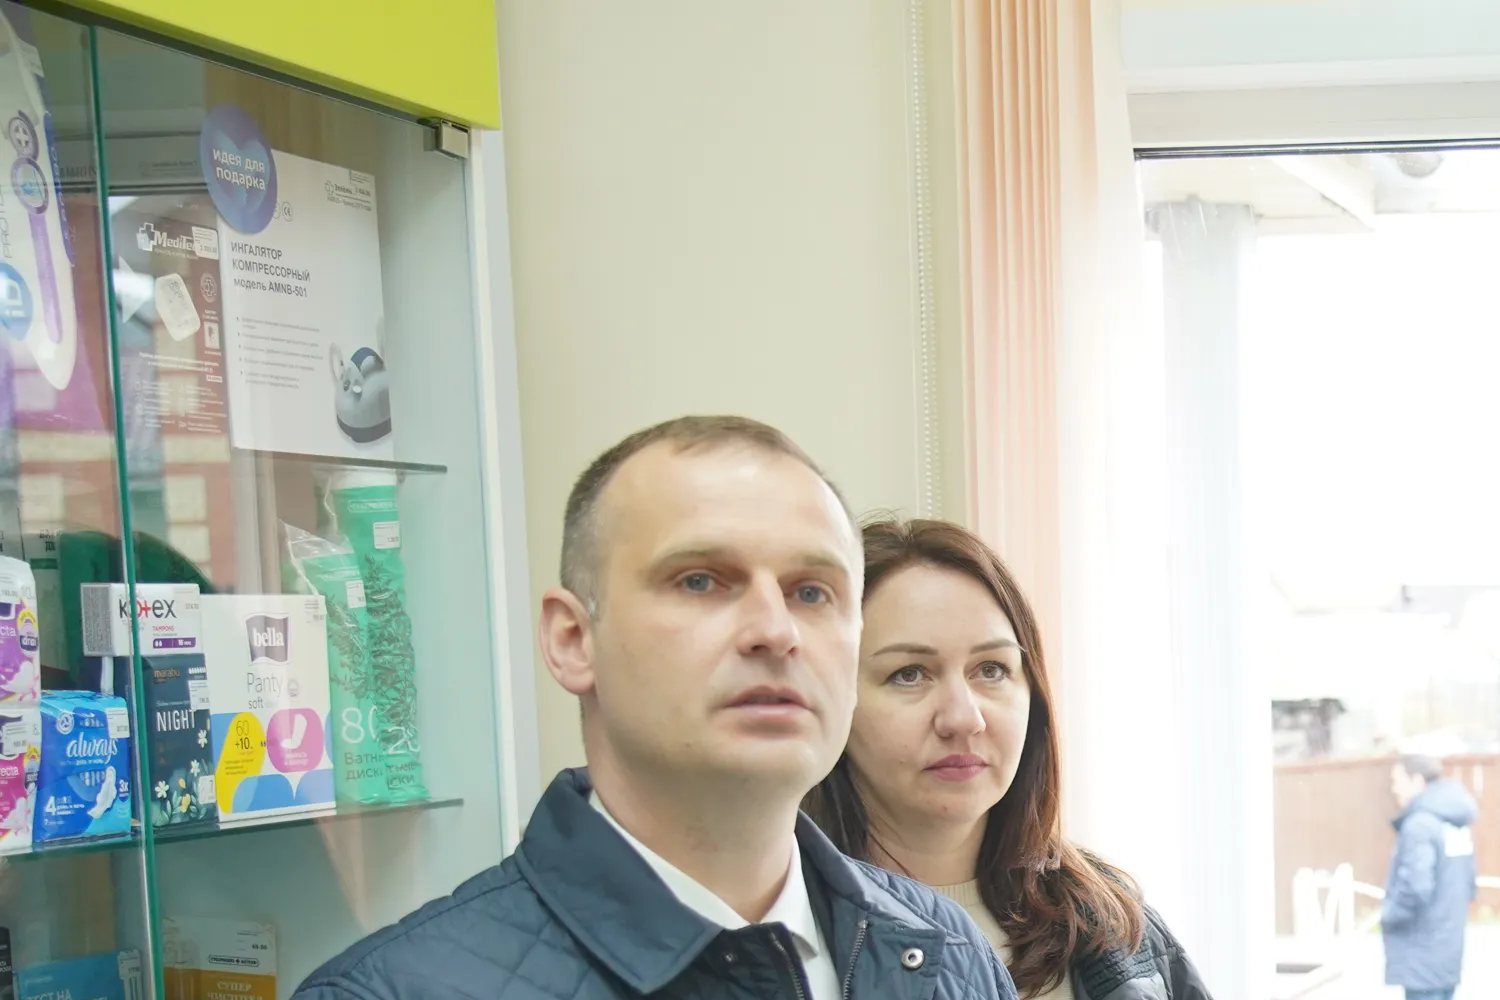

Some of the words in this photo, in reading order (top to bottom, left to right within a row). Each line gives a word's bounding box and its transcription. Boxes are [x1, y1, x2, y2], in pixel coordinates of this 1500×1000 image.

[213, 149, 241, 166] идея
[245, 157, 265, 173] для
[216, 167, 265, 190] подарка
[231, 242, 283, 260] ИНГАЛЯТОР
[232, 259, 311, 282] КОМПРЕССОРНЫЙ
[234, 278, 267, 291] модель
[268, 281, 308, 297] AMNB-501
[253, 627, 285, 647] bella
[154, 668, 181, 678] marabu
[247, 673, 284, 698] Panty
[249, 697, 263, 710] soft
[157, 709, 195, 732] NIGHT
[236, 719, 250, 736] 60
[66, 732, 118, 765] always
[45, 796, 57, 815] 4
[217, 981, 252, 992] СУПЕР
